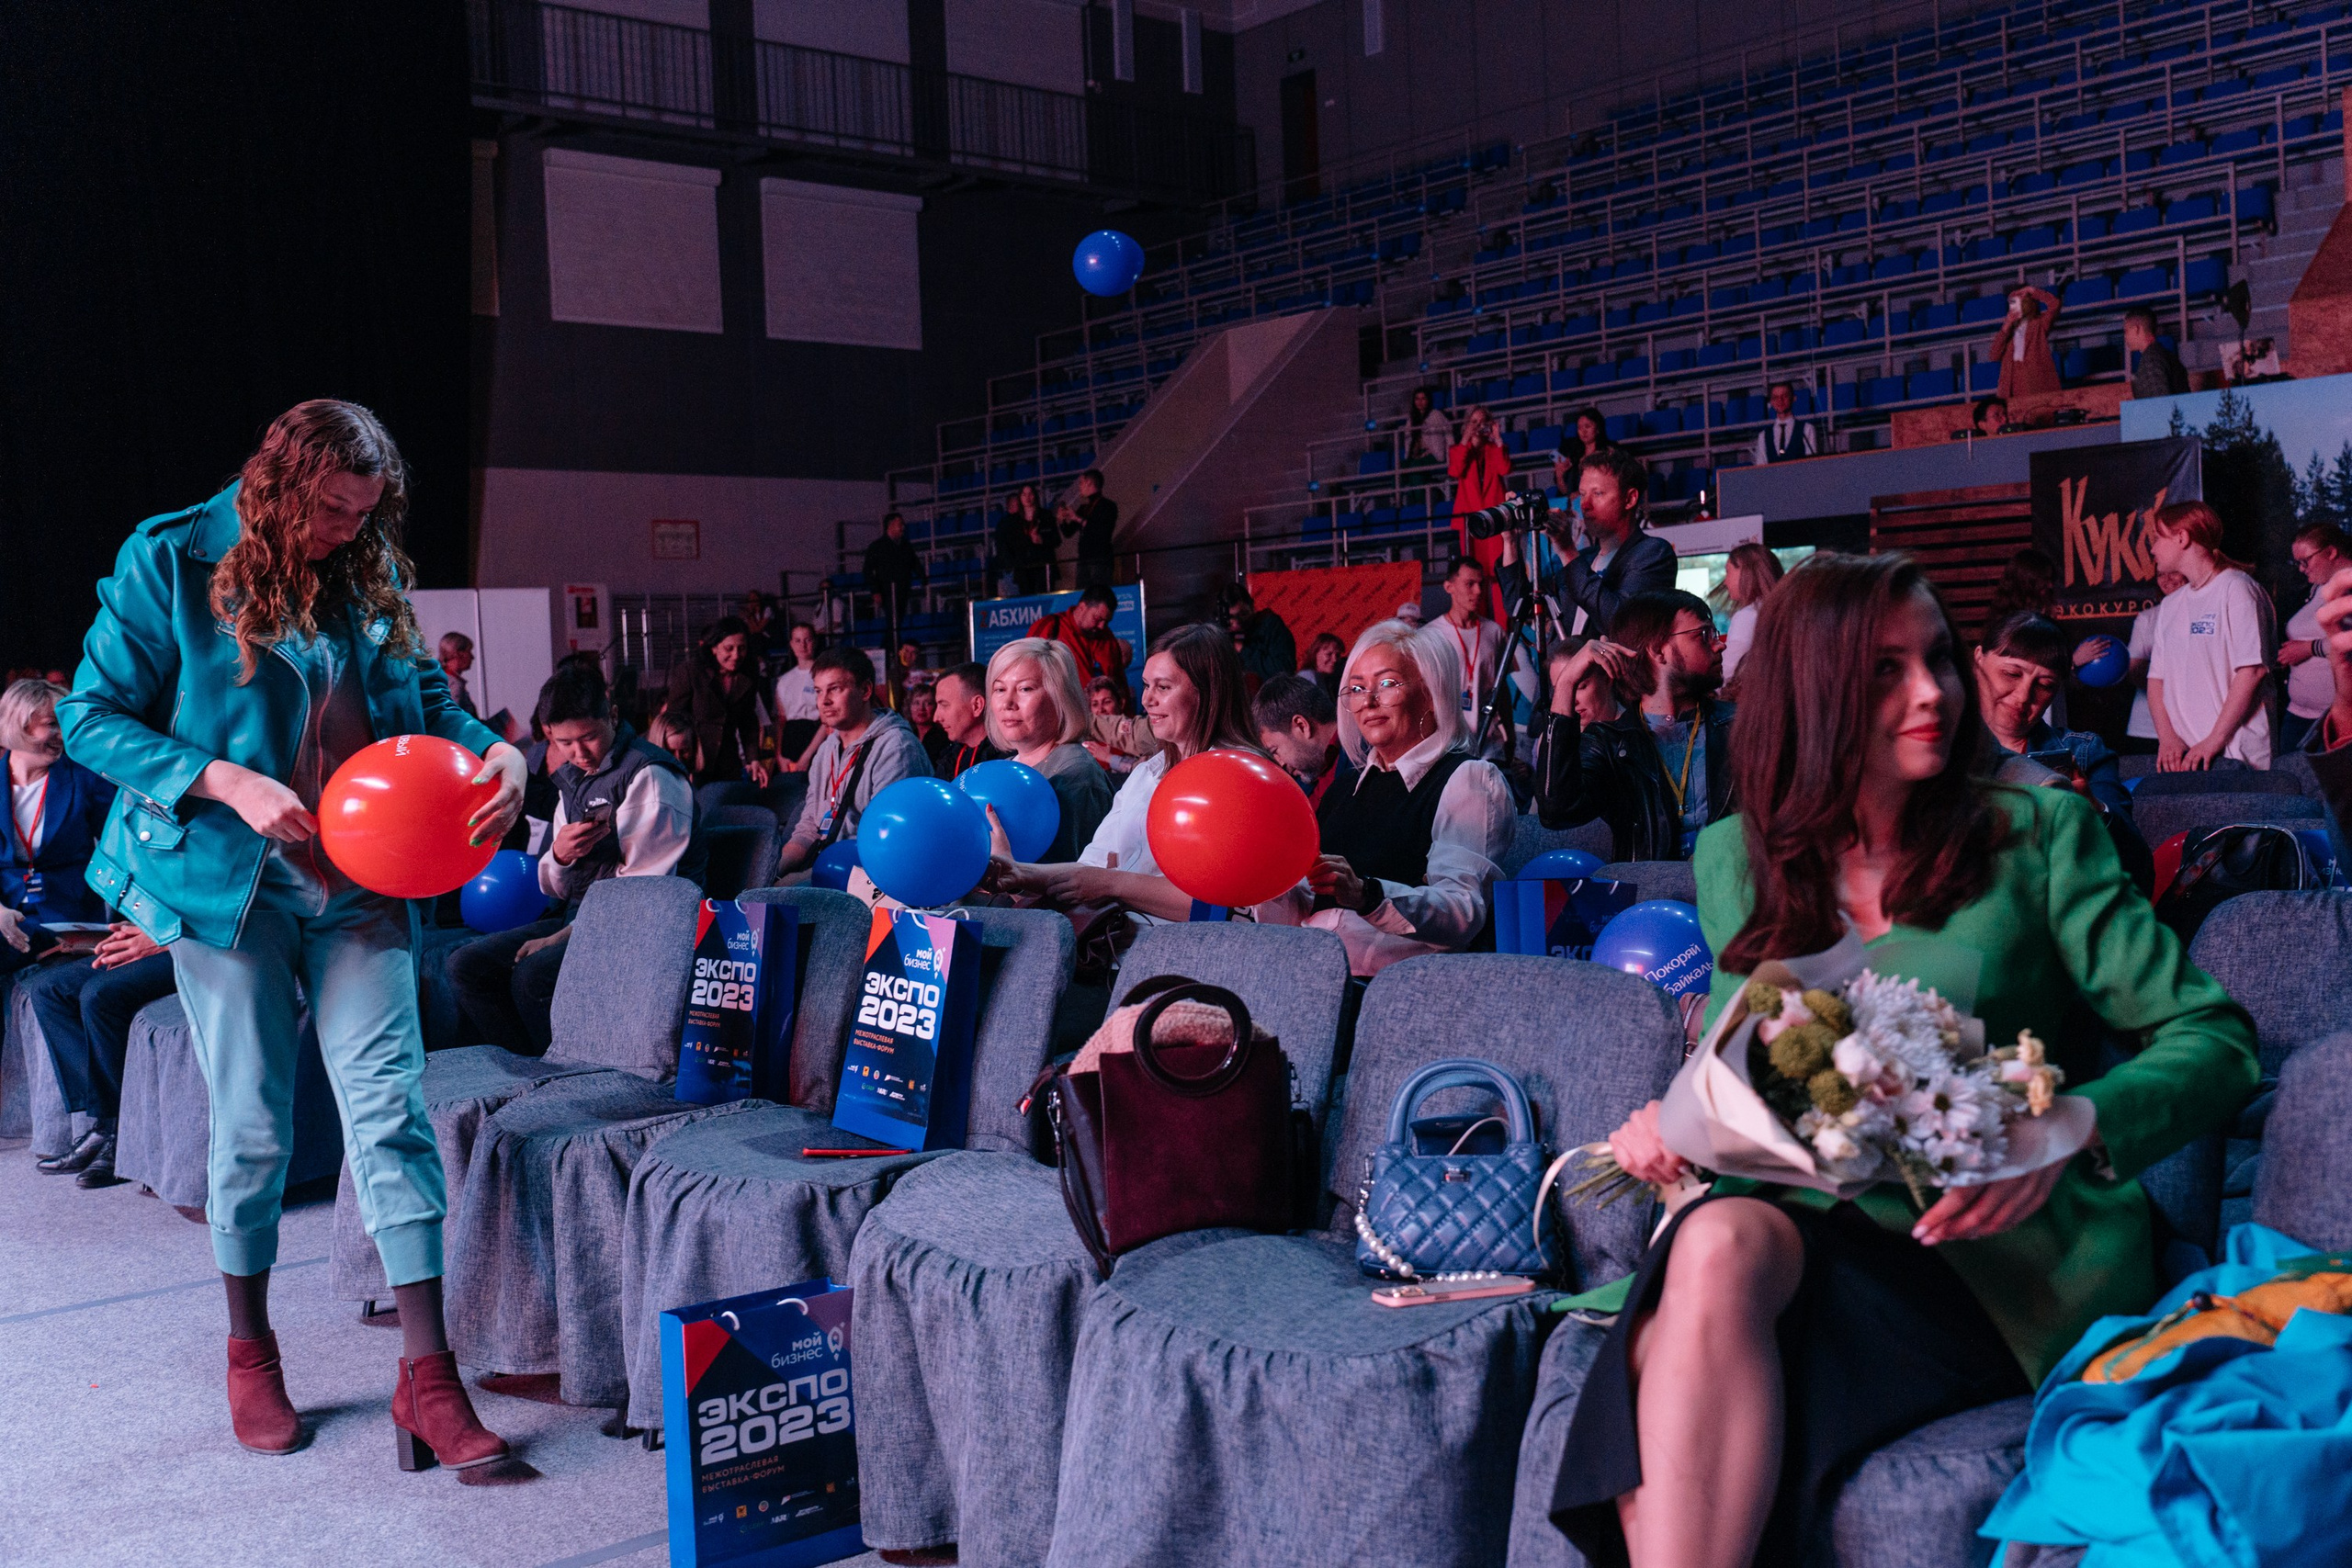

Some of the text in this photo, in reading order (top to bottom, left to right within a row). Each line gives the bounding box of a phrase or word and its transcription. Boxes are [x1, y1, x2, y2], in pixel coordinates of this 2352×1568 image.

[728, 938, 750, 951] бизнес
[737, 930, 750, 941] мой
[904, 953, 932, 971] бизнес
[916, 947, 933, 960] мой
[1644, 943, 1702, 981] Покоряй
[695, 957, 757, 983] ЭКСПО
[691, 979, 754, 1011] 2023
[865, 971, 940, 1009] ЭКСПО
[857, 995, 936, 1041] 2023
[792, 1331, 822, 1351] мой
[771, 1347, 823, 1369] бизнес
[697, 1368, 849, 1427] ЭКСПО
[700, 1396, 852, 1466] 2023
[701, 1455, 779, 1482] МЕЖОТРАСЛЕВАЯ
[701, 1465, 786, 1494] ВЫСТАВКА-ФОРУМ
